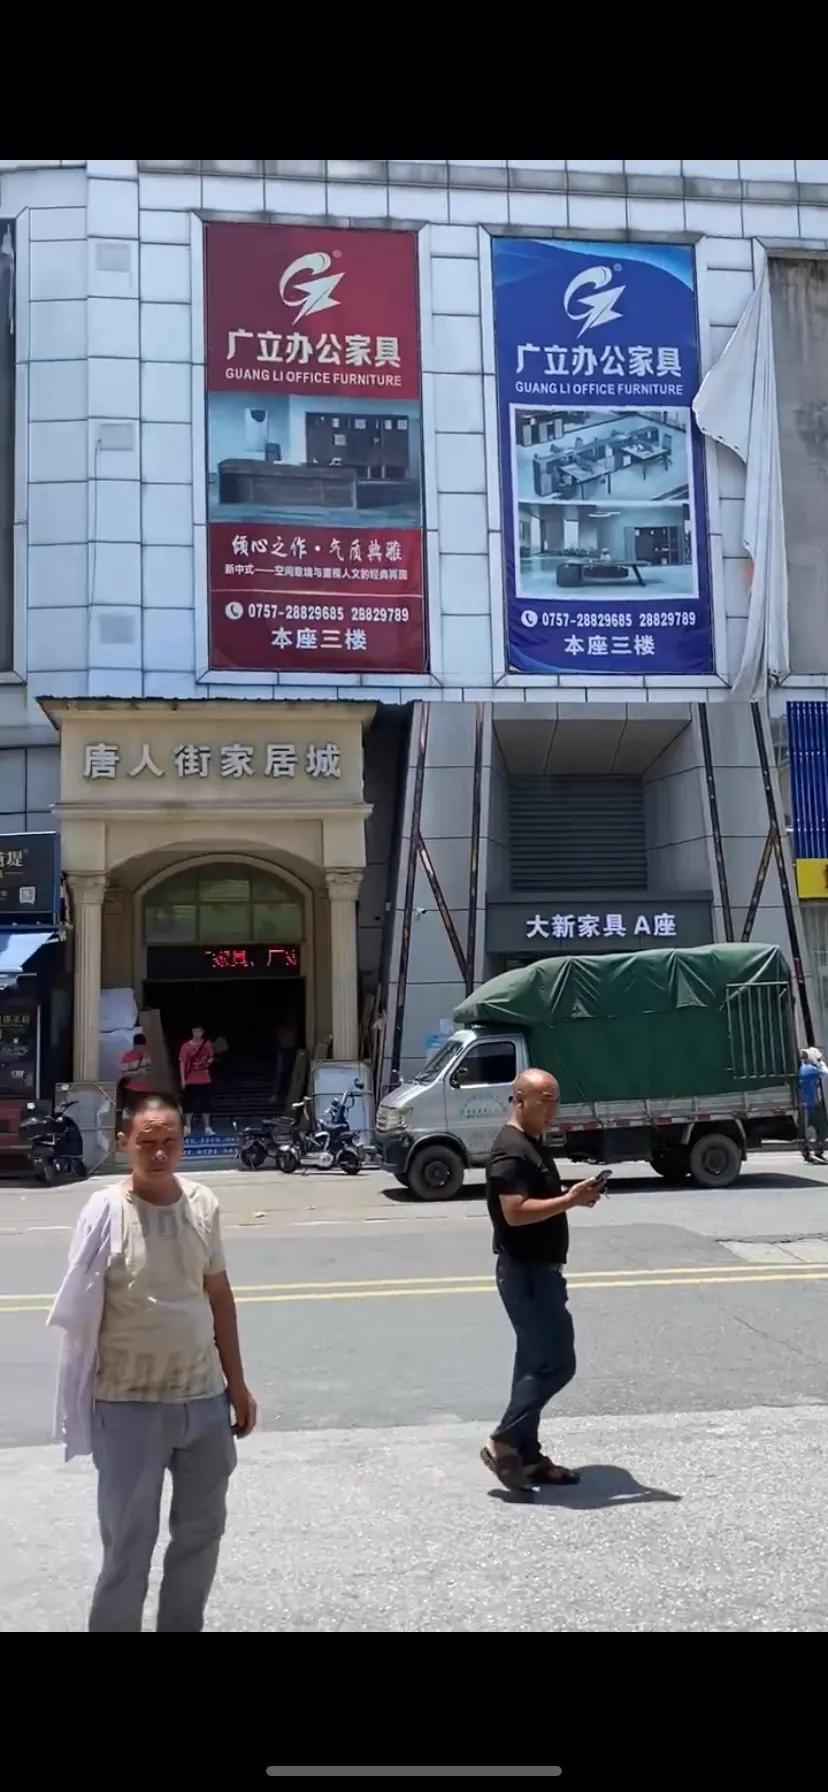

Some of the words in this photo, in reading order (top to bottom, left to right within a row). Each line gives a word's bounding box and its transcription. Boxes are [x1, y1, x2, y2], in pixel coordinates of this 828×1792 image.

[226, 328, 402, 369] 广立办公家具
[515, 343, 683, 378] 广立办公家具
[225, 367, 270, 381] GUANG
[272, 370, 284, 382] LI
[286, 371, 331, 384] OFFICE
[333, 373, 402, 387] FURNITURE
[515, 381, 558, 394] GUANG
[559, 382, 571, 394] LI
[573, 383, 615, 395] OFFICE
[617, 383, 684, 396] FURNITURE
[247, 603, 345, 621] 0757-28829685
[351, 606, 410, 622] 28829789
[541, 612, 633, 628] 0757-28829685
[639, 611, 697, 628] 28829789
[271, 626, 368, 650] 本座三楼
[564, 634, 656, 656] 本座三楼
[83, 743, 341, 779] 唐人街家居城
[525, 914, 627, 939] 大新家具
[633, 912, 677, 937] A座
